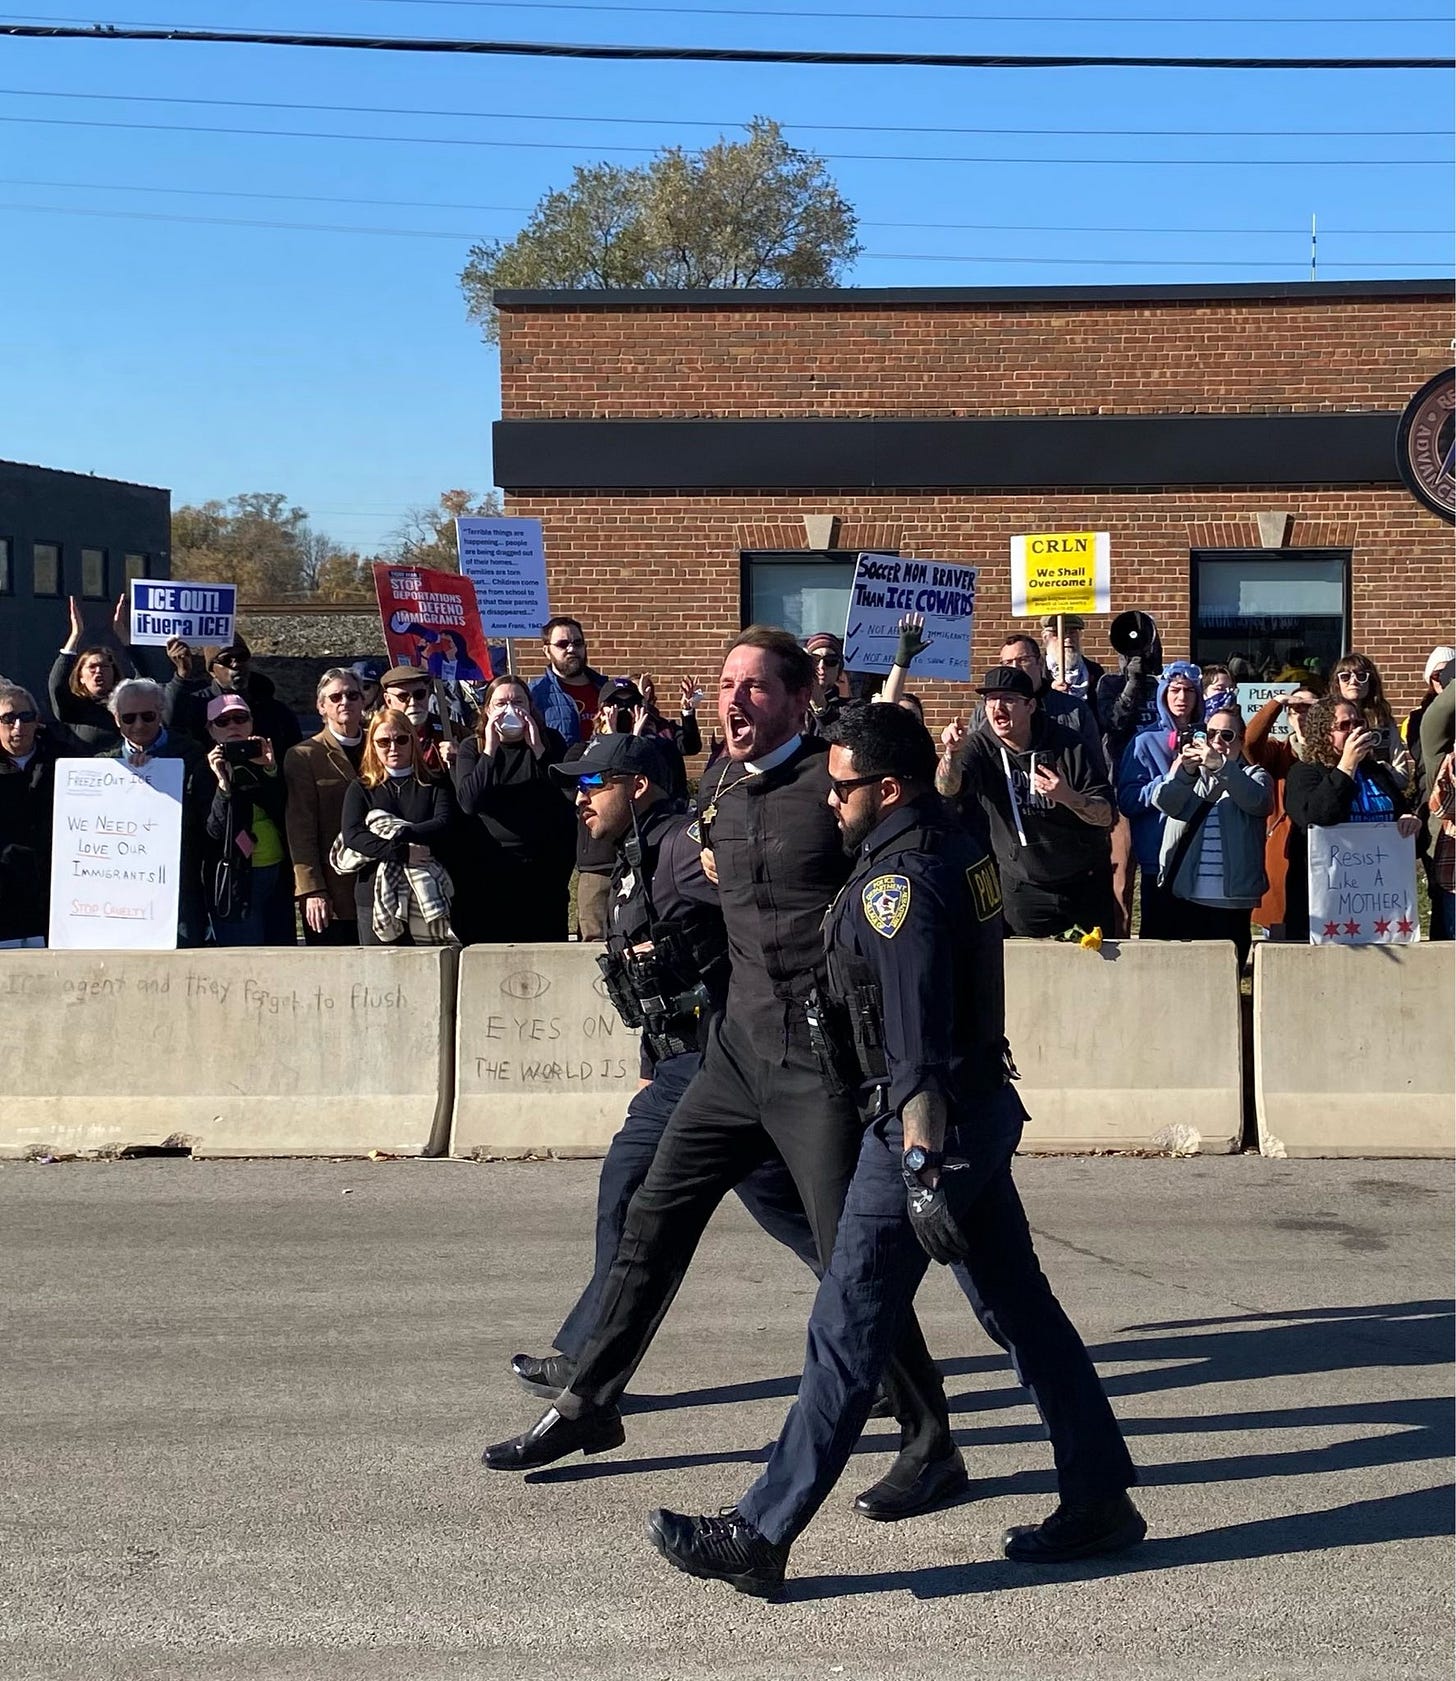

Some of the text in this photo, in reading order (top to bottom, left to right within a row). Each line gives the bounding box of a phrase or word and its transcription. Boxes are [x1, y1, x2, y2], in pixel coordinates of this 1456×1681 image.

[1032, 538, 1088, 554] CRLN
[856, 555, 902, 583] SOCCER
[932, 567, 976, 592] BRAVER
[1036, 567, 1085, 577] We Shall
[390, 579, 422, 591] STOP
[148, 587, 220, 612] ICE OUT!
[392, 590, 462, 604] DEPORTATIONS
[855, 583, 975, 616] THAN ICE COWARDS
[418, 601, 464, 616] DEFEND
[198, 616, 230, 636] ICE!
[396, 611, 466, 627] IMMIGRANTS
[867, 624, 885, 635] NOT
[864, 653, 881, 662] NOT
[67, 816, 89, 832] WE
[96, 815, 138, 833] NEED
[78, 839, 109, 855] LOVE
[1329, 845, 1390, 867] Resist
[1327, 869, 1384, 890] Like A
[71, 898, 99, 913] STOP
[62, 972, 126, 1001] agent
[136, 972, 171, 994] and
[314, 985, 335, 1011] to
[351, 982, 408, 1010] flush
[485, 1014, 616, 1041] EYES ON
[475, 1057, 627, 1083] THE WORLD IS
